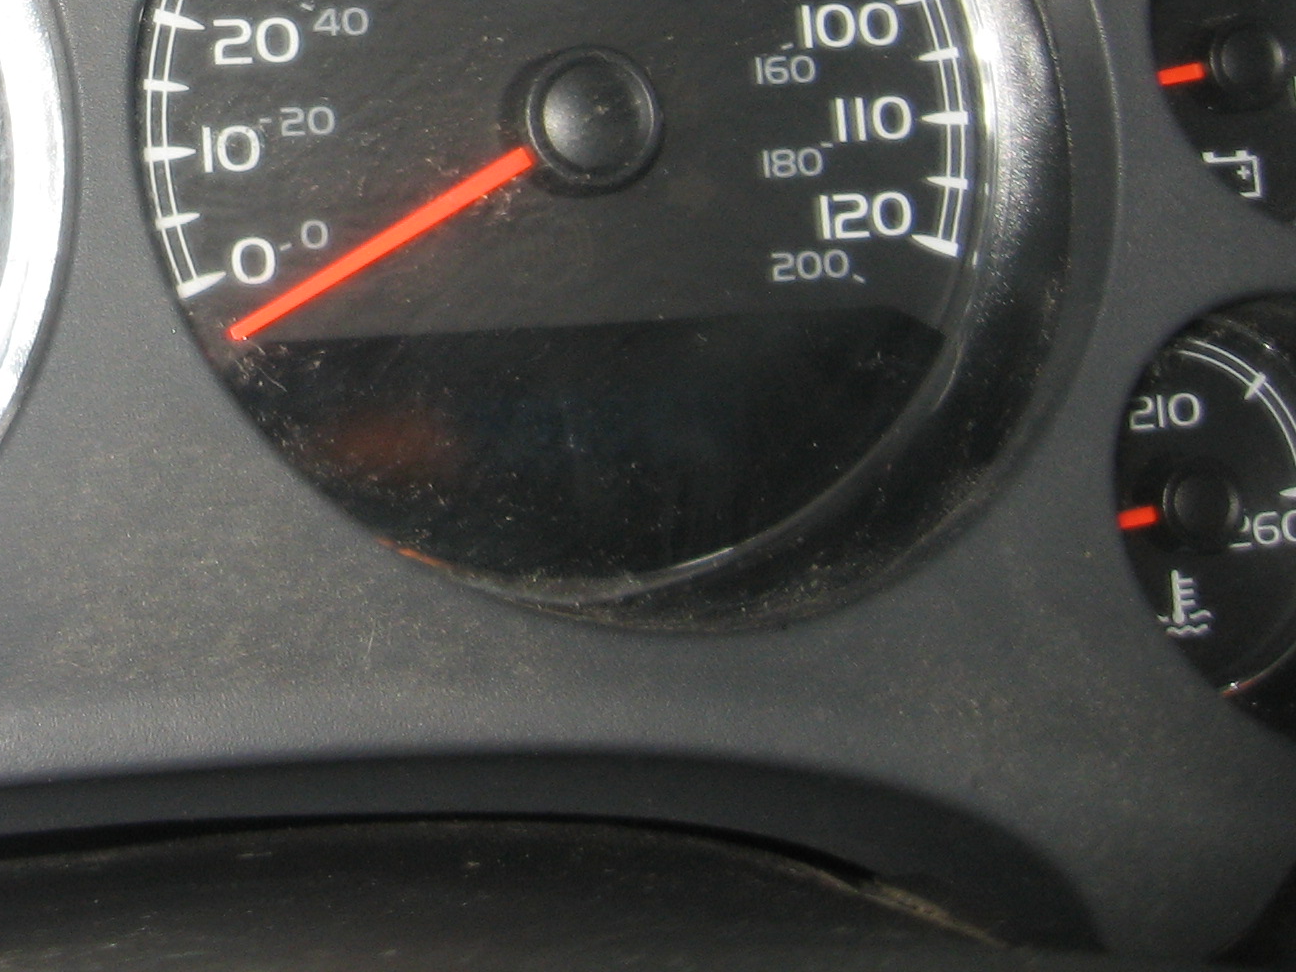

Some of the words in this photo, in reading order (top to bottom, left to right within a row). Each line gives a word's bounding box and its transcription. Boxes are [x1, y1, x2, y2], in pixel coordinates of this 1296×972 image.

[213, 16, 302, 66] 20
[313, 6, 370, 37] 40
[799, 3, 901, 49] 100
[755, 54, 816, 85] 160
[280, 106, 336, 137] 20
[832, 95, 912, 143] 110
[202, 125, 261, 174] 10
[762, 148, 823, 178] 180
[301, 220, 330, 250] 0
[817, 191, 914, 241] 120
[230, 237, 277, 284] 0
[770, 250, 850, 283] 200
[1129, 392, 1201, 431] 210
